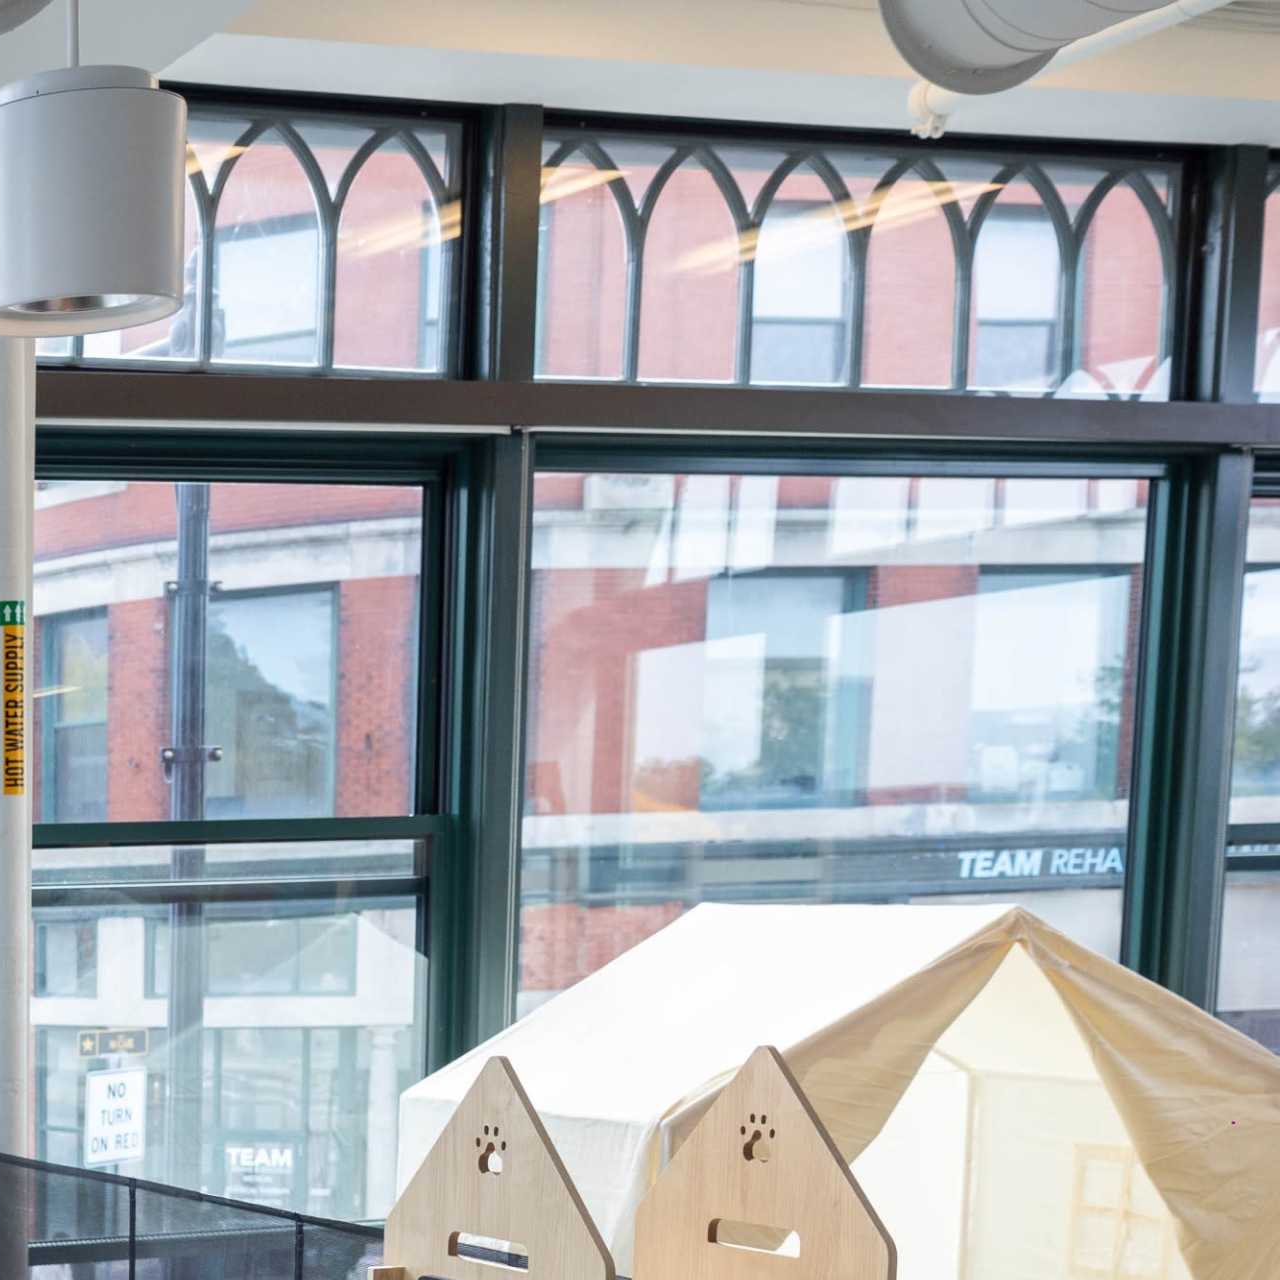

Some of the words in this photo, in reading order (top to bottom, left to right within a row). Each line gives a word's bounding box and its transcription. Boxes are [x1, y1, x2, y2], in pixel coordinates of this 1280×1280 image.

[5, 633, 24, 693] SUPPLY
[5, 699, 24, 752] WATER
[5, 757, 24, 787] HOT
[958, 850, 1042, 878] TEAM
[1050, 848, 1123, 874] REHA
[107, 1082, 126, 1099] NO
[100, 1107, 133, 1127] TURN
[91, 1136, 108, 1153] ON
[115, 1132, 139, 1150] RED
[225, 1147, 292, 1168] TEAM
